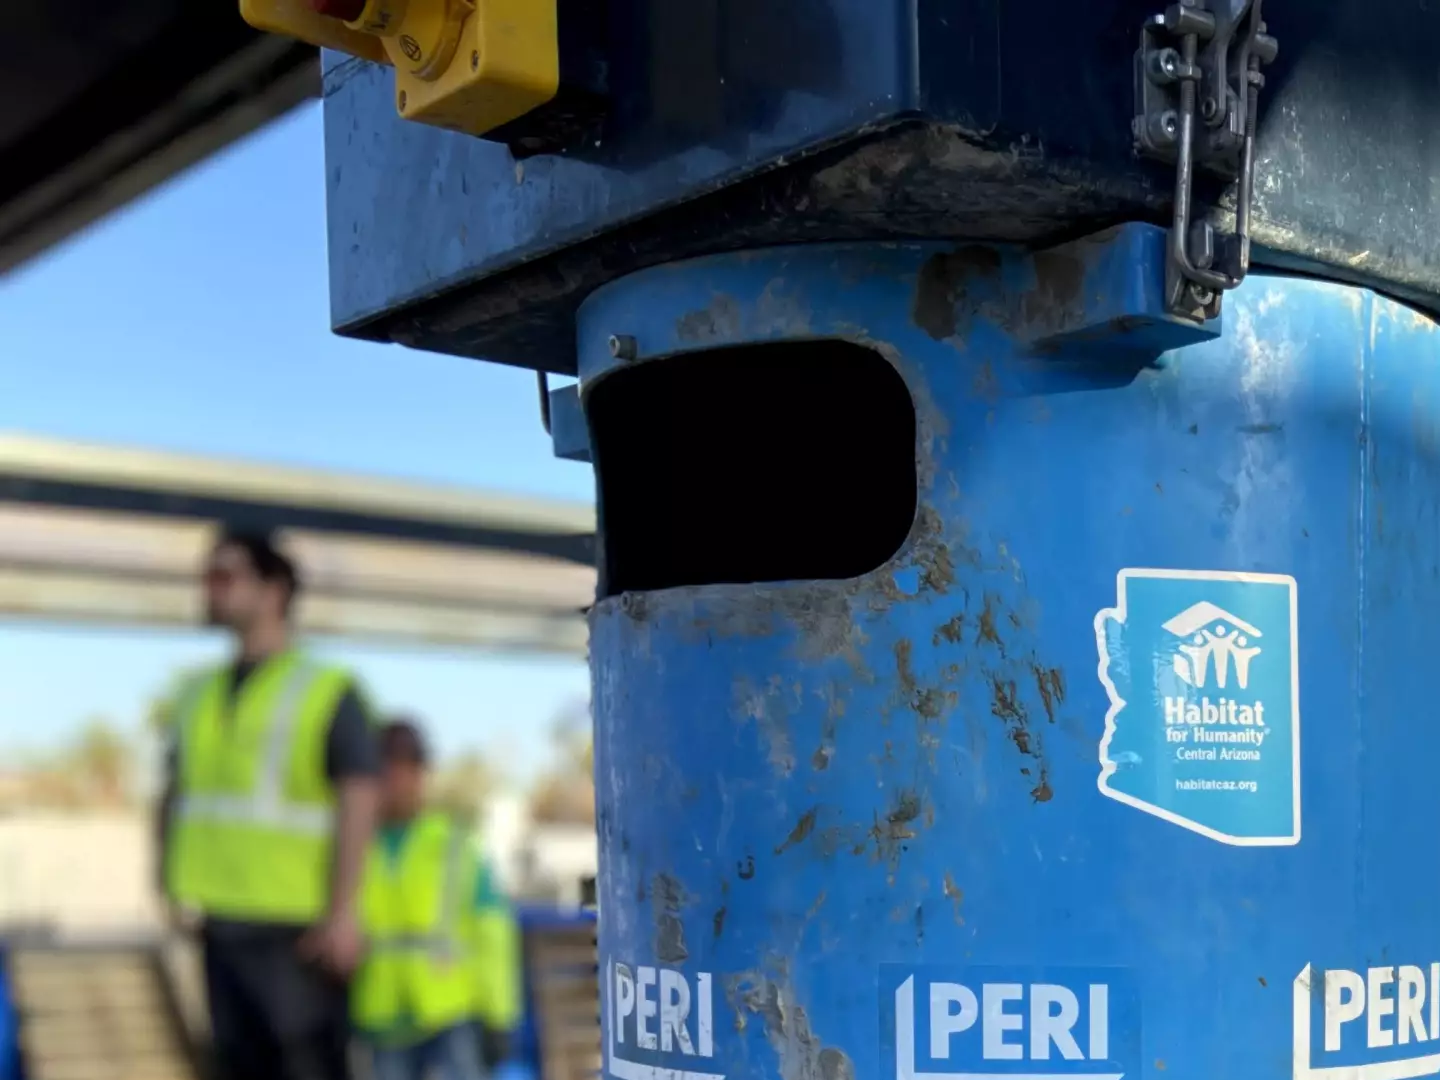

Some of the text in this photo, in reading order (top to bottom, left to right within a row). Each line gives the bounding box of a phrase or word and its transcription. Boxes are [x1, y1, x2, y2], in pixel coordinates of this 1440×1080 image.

[1165, 696, 1265, 726] Habitat
[1166, 726, 1188, 742] for
[1176, 747, 1260, 760] Central Arizona
[1175, 779, 1257, 792] habitatcaz.org
[615, 962, 713, 1057] PERI
[929, 982, 1108, 1060] PERI
[1325, 963, 1440, 1051] PERI
